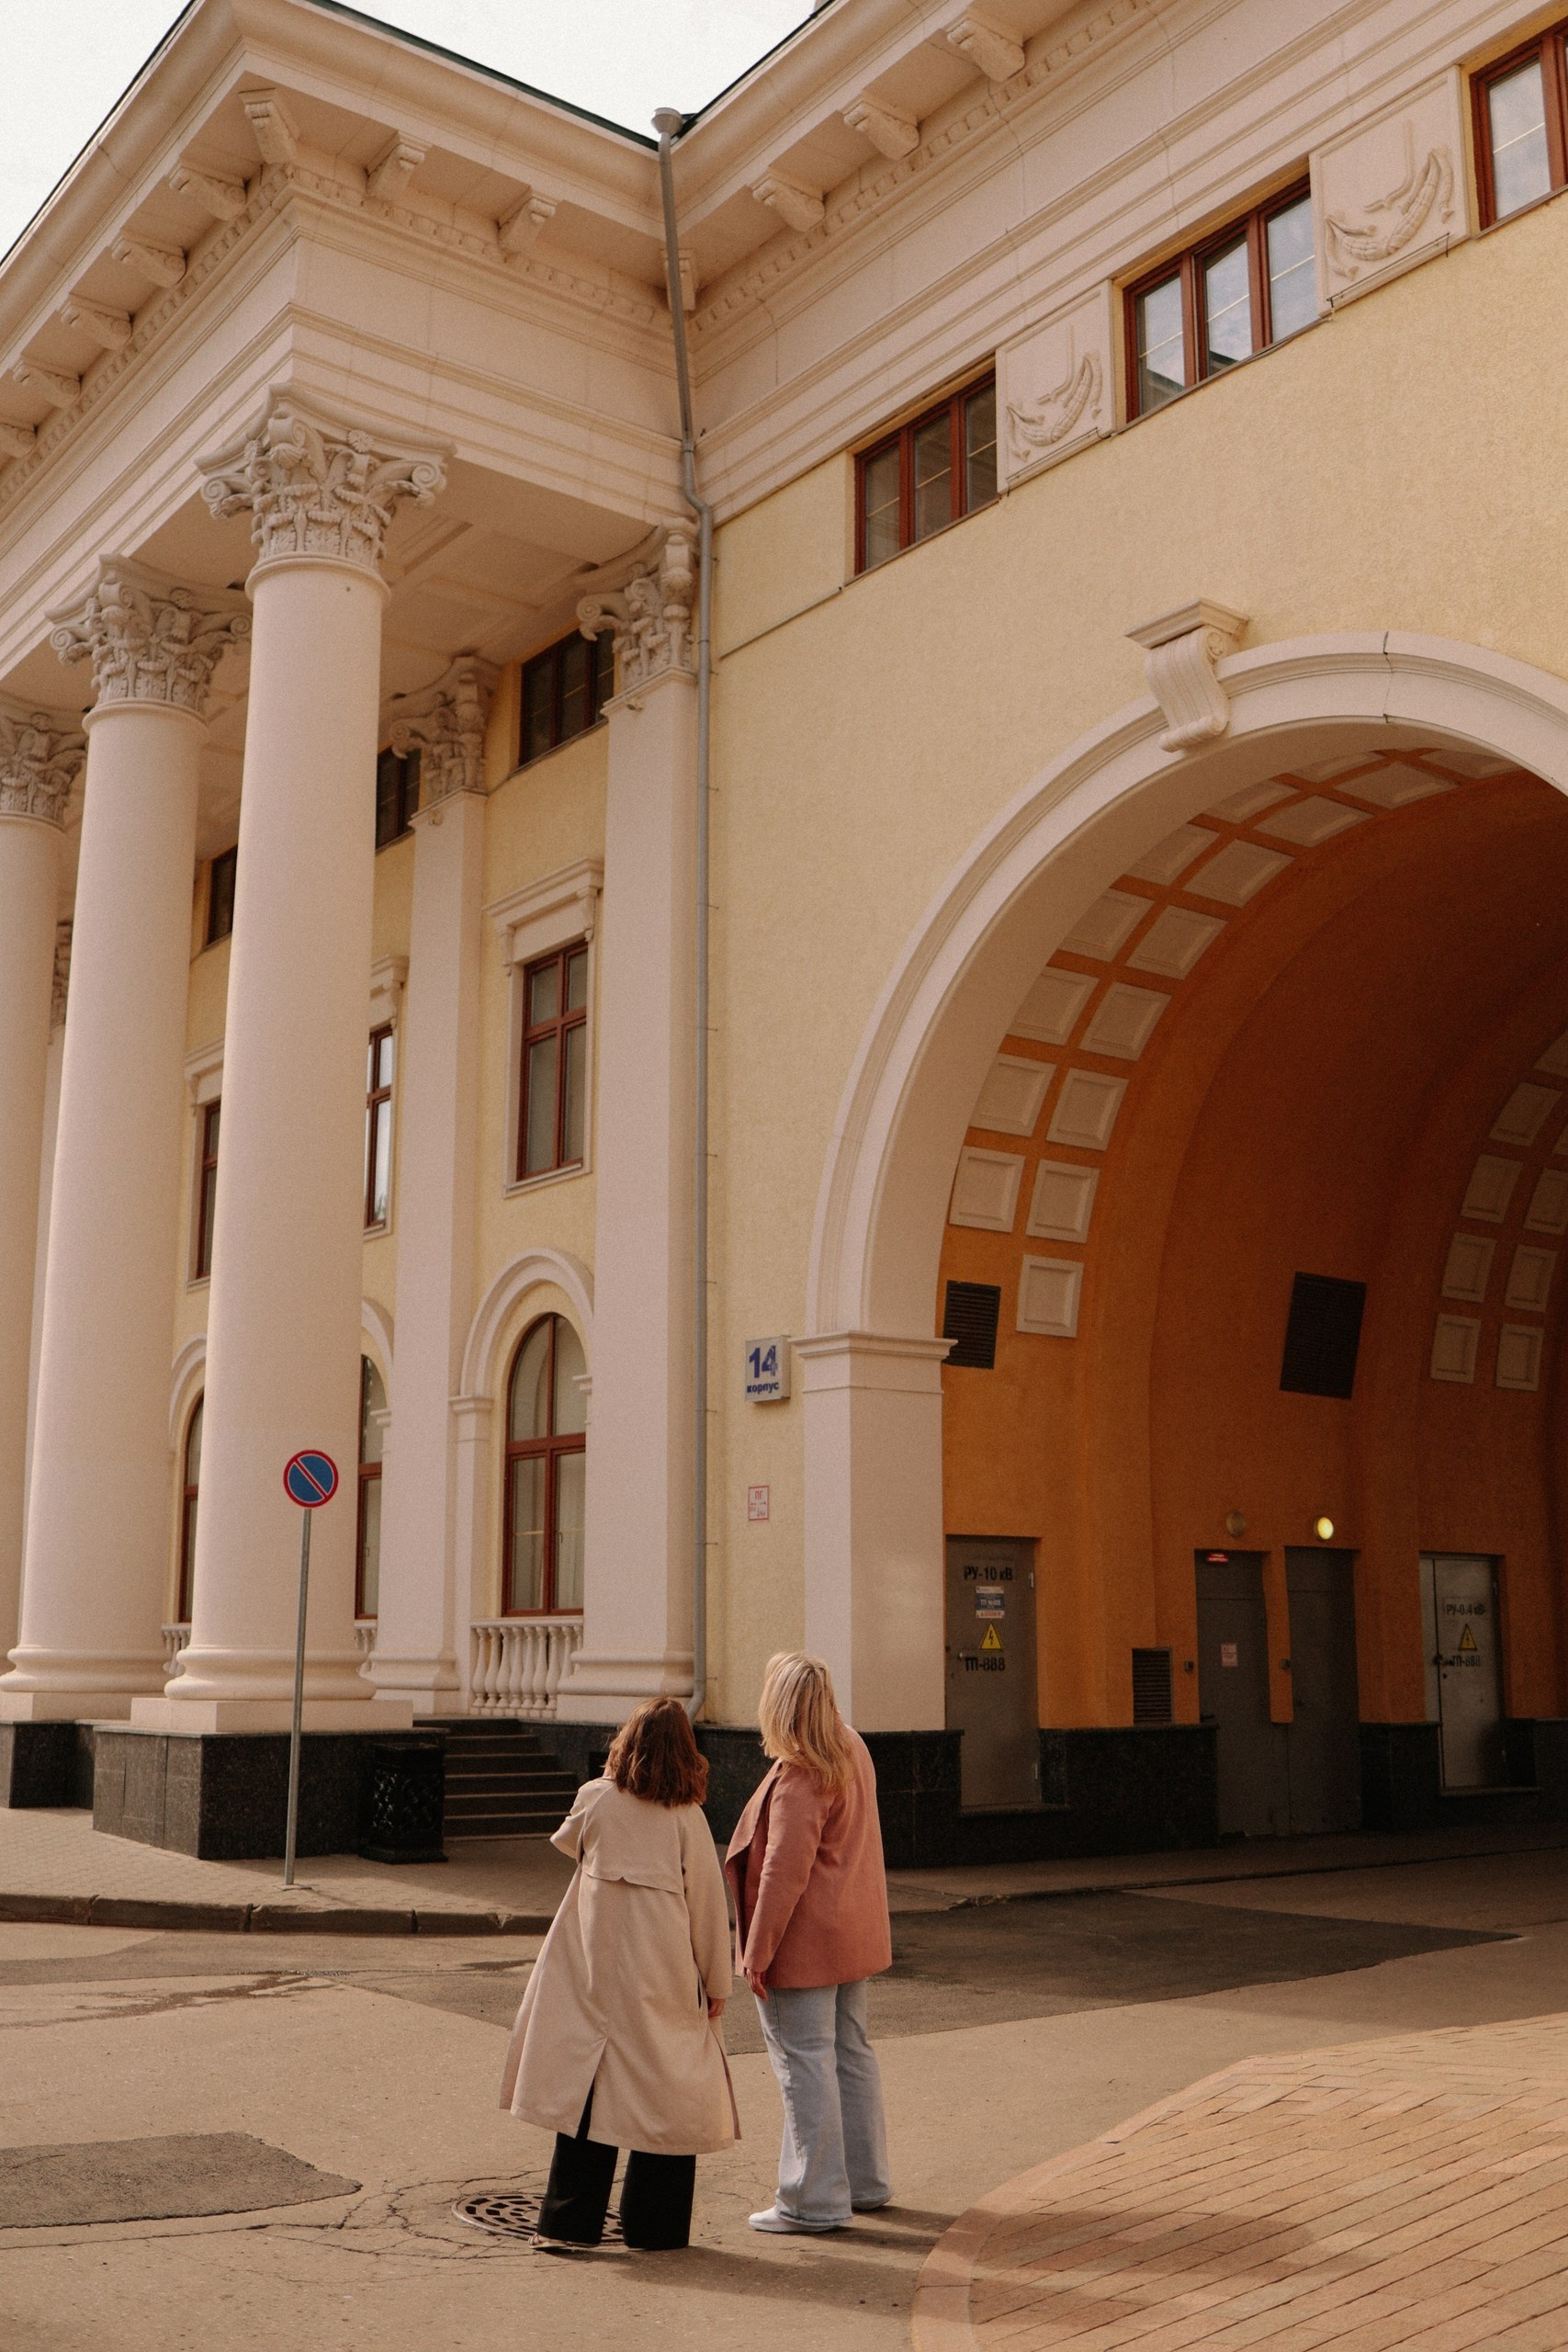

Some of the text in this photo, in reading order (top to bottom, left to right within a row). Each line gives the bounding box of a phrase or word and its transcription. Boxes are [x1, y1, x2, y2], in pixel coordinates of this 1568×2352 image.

[749, 1345, 778, 1379] 14
[746, 1382, 779, 1395] корпус
[963, 1566, 1013, 1581] РУ-10 кВ
[964, 1657, 1006, 1672] ТП-888
